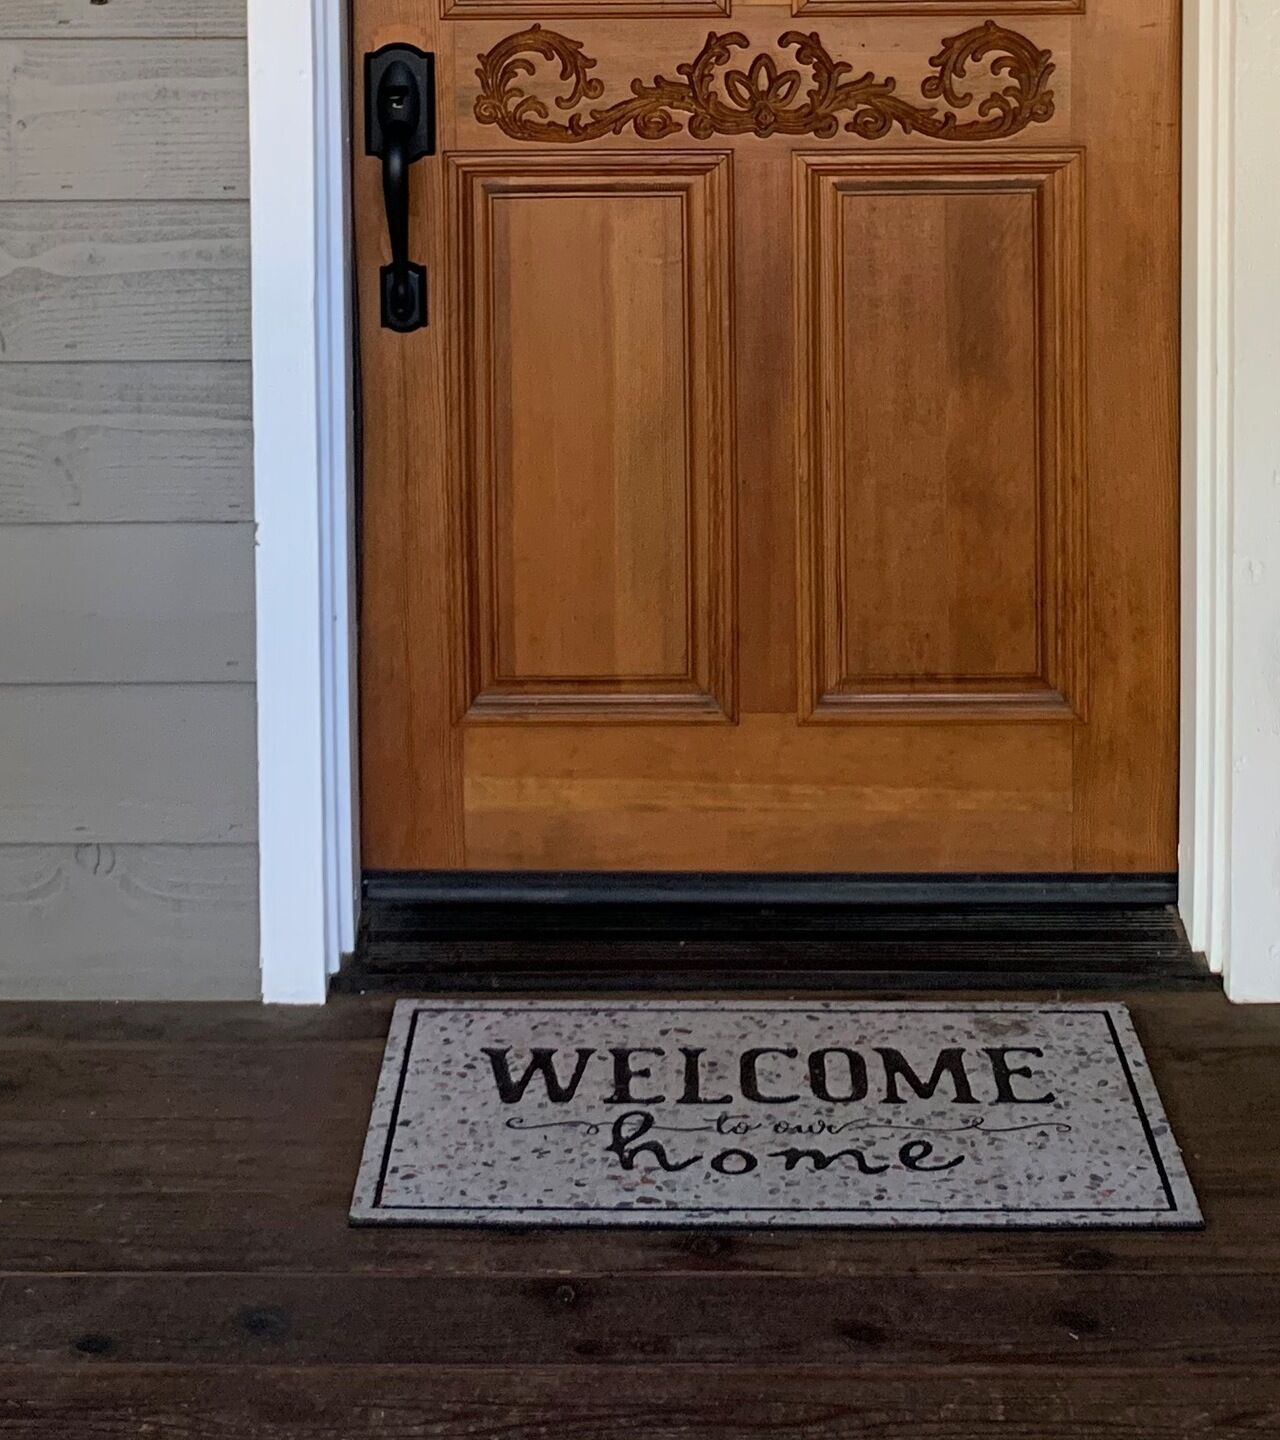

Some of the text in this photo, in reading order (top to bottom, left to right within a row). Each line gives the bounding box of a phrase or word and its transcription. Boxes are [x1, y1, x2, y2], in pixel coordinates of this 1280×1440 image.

[480, 1046, 1056, 1104] WELCOME
[605, 1110, 965, 1175] home
[715, 1112, 761, 1135] to
